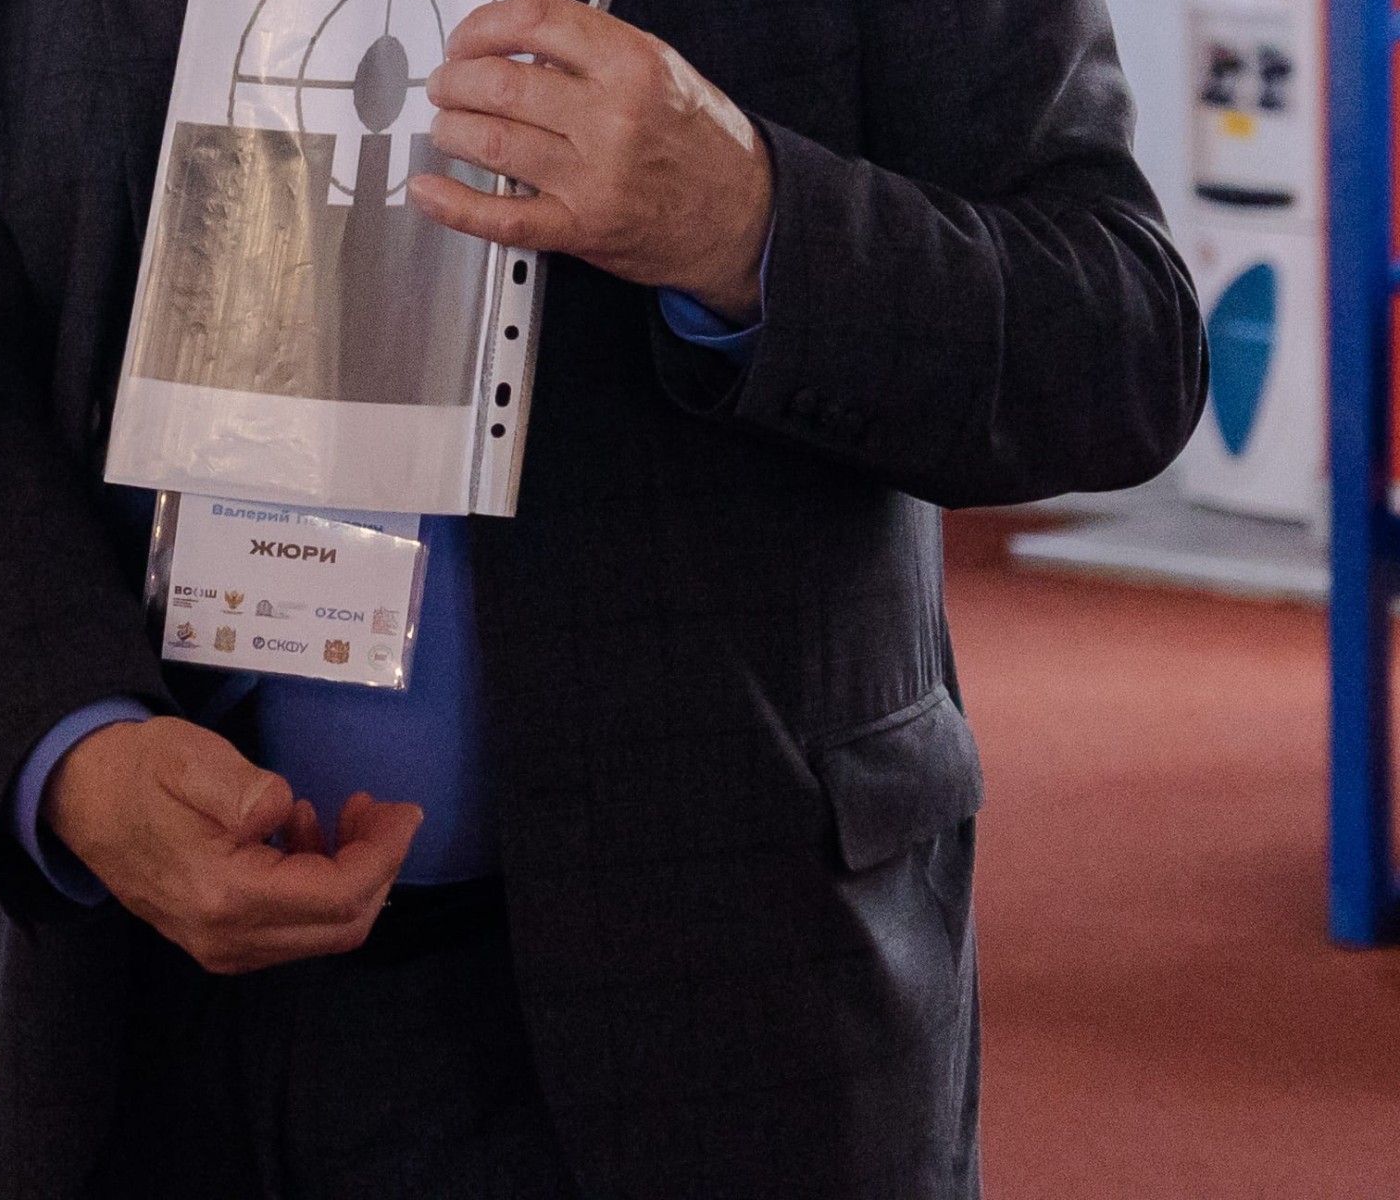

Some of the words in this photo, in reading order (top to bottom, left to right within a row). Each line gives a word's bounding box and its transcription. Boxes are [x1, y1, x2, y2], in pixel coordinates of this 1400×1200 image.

[212, 503, 290, 524] Валерий
[249, 539, 337, 564] ЖЮРИ
[315, 607, 365, 622] OZON
[267, 638, 309, 654] СКФУ
